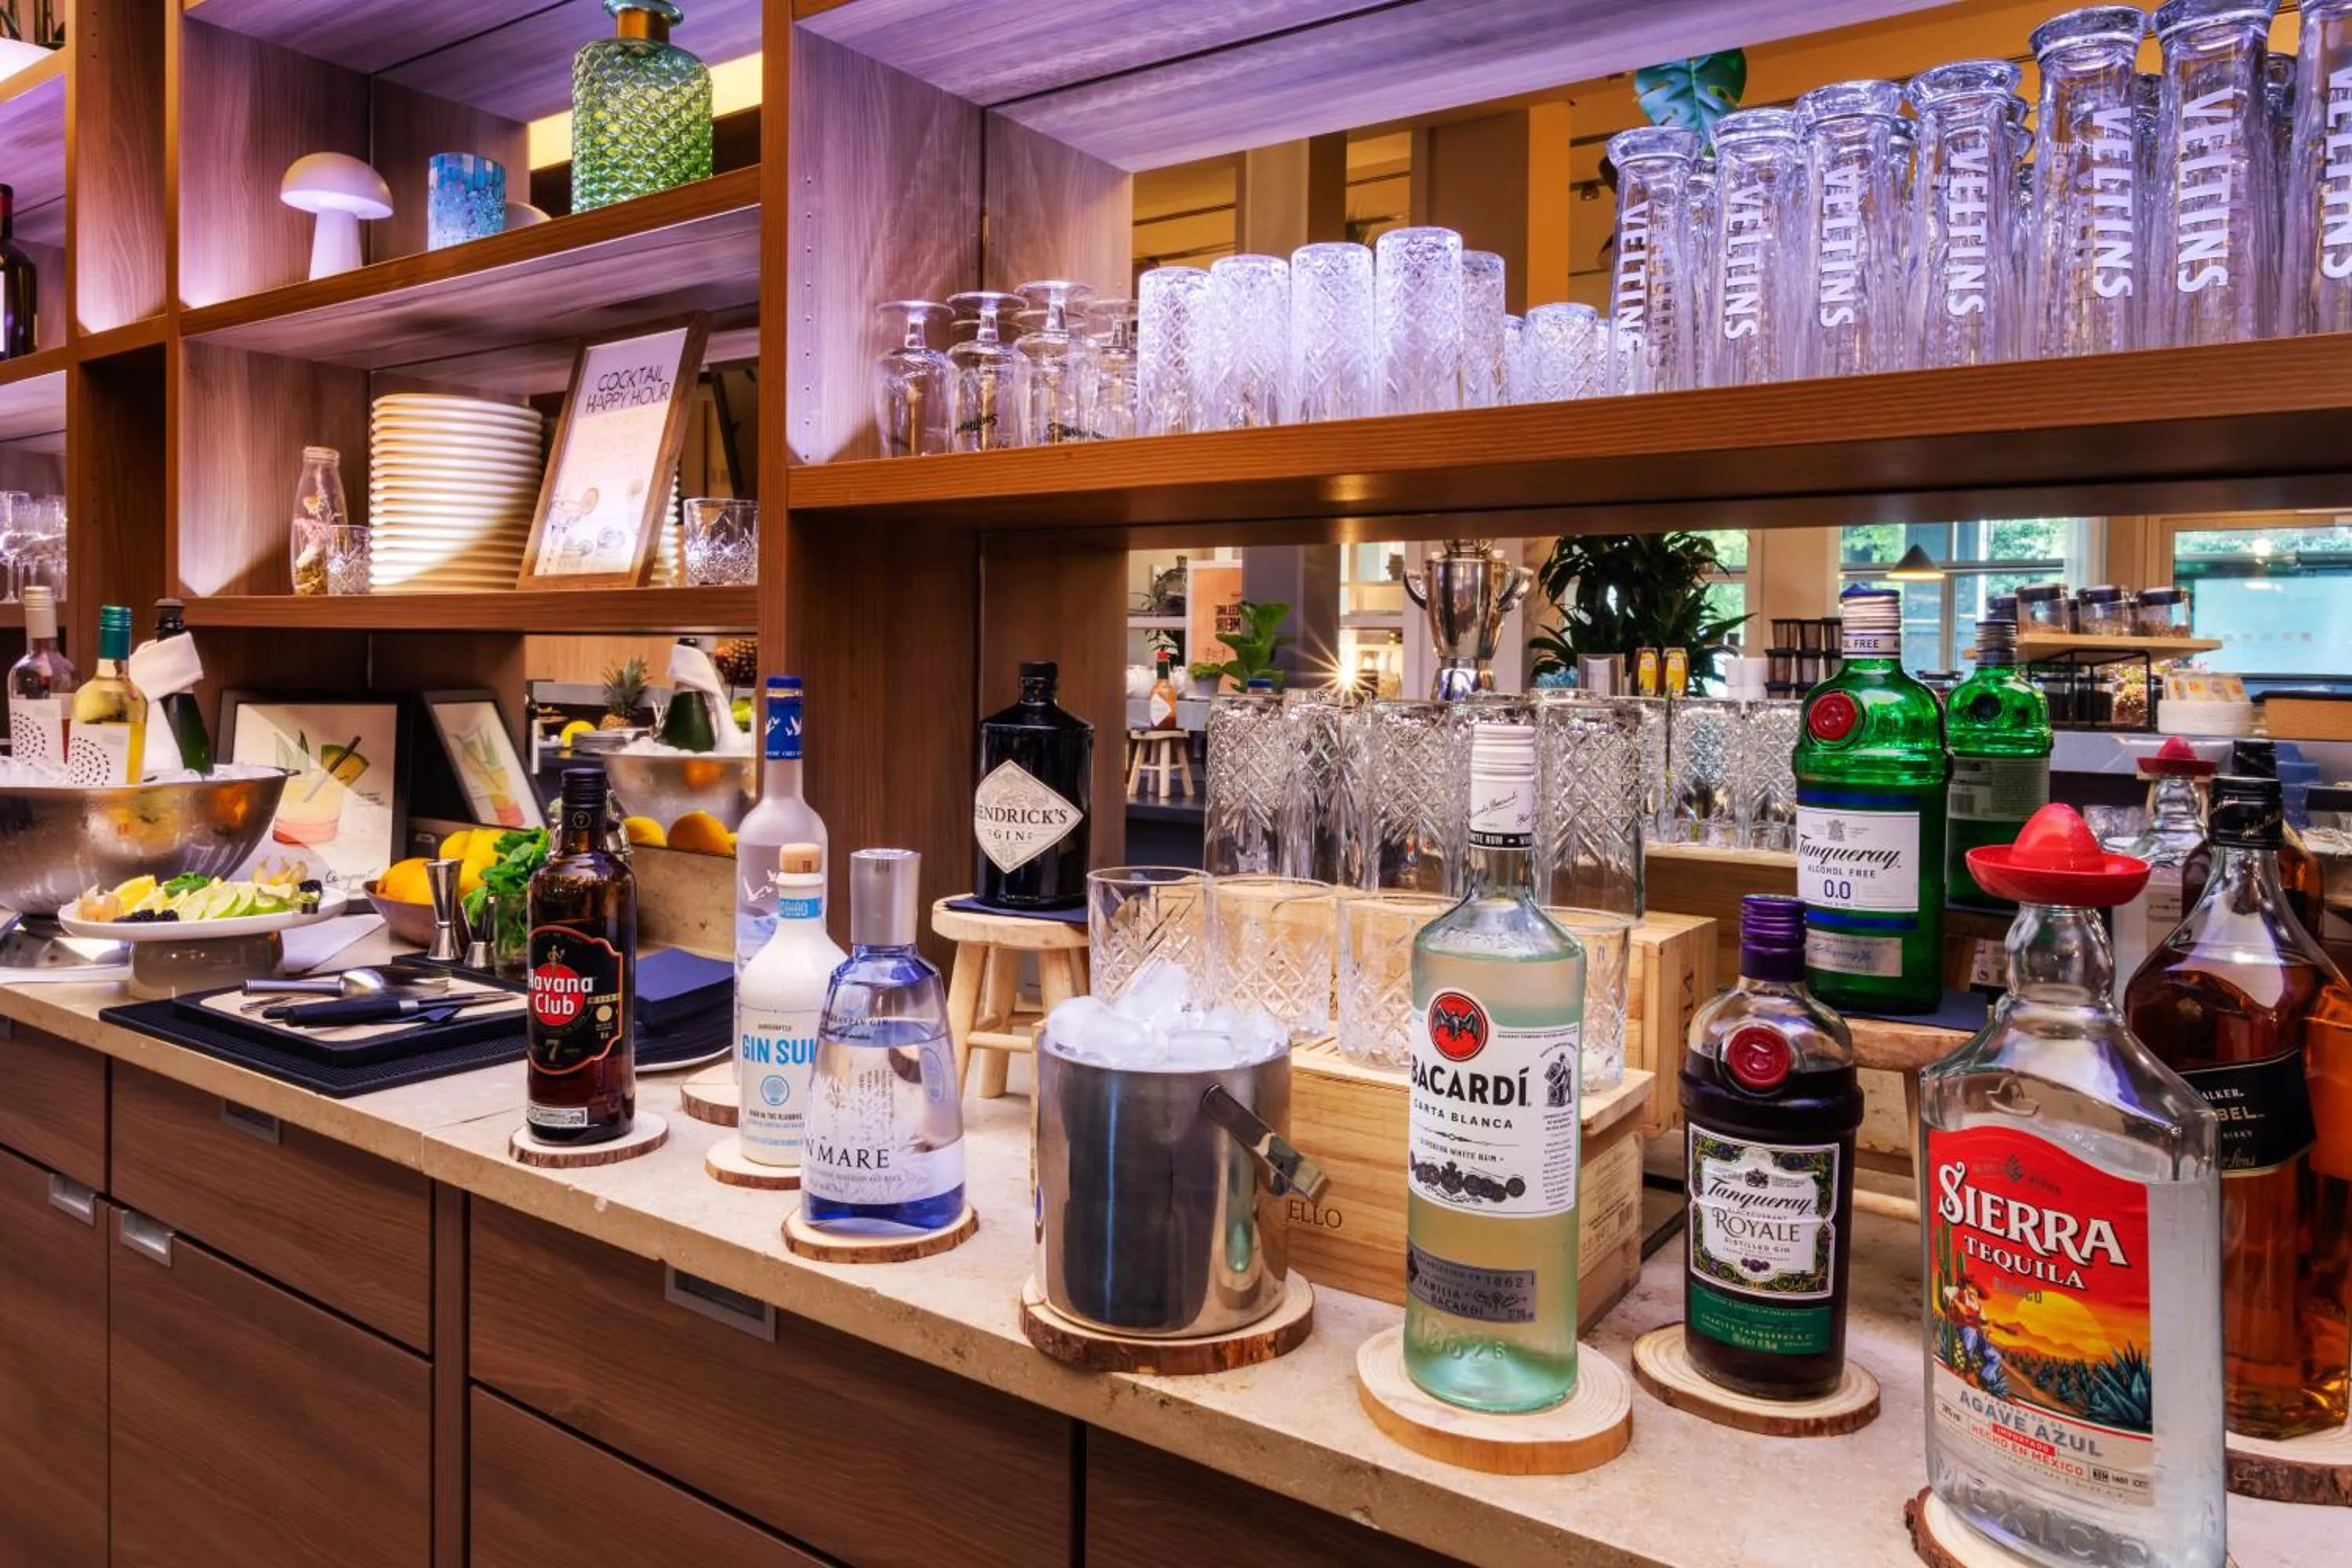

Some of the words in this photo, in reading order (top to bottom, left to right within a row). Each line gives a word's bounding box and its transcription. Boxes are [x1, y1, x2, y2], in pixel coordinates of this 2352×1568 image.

[2092, 106, 2133, 298] VELTINS
[2176, 85, 2234, 292] VELTINS
[1947, 143, 1989, 317] VELTINS
[1724, 182, 1764, 339] VELTINS
[1819, 164, 1859, 328] VELTINS
[1617, 200, 1650, 351] VELTINS
[597, 365, 664, 392] COCKTAIL
[586, 391, 630, 413] HAPPY
[630, 382, 671, 409] HOUR
[1854, 639, 1880, 648] FREE
[976, 802, 1068, 824] ENDRICK'S
[993, 829, 1025, 841] GIN
[1798, 833, 1902, 871] Tanqueray
[1807, 865, 1843, 877] ALCOHOL
[1849, 869, 1877, 879] FREE
[1824, 879, 1852, 900] 0.0
[528, 968, 593, 993] Havana
[535, 993, 575, 1015] Club
[546, 1039, 561, 1061] 7
[742, 1034, 771, 1064] GIN
[1412, 1053, 1530, 1107] BACARDÍ
[2201, 1087, 2241, 1101] ALKER
[1414, 1098, 1445, 1120] CARTA
[1450, 1112, 1514, 1130] BLANCA
[2215, 1105, 2257, 1122] BEL
[817, 1144, 891, 1171] MARE
[1450, 1147, 1476, 1160] WHITE
[1477, 1152, 1497, 1163] RUM
[1707, 1177, 1813, 1217] Tanqueray
[1711, 1207, 1801, 1243] ROYALE
[1937, 1161, 2129, 1267] SIERRA
[1963, 1234, 2086, 1290] TEQUILA
[1486, 1276, 1524, 1288] 1862
[1960, 1390, 2027, 1433] AGAVE
[2035, 1423, 2104, 1457] AZUL
[1971, 1425, 2009, 1449] HECHO
[2011, 1444, 2028, 1457] EN
[2031, 1450, 2085, 1477] MEXICO
